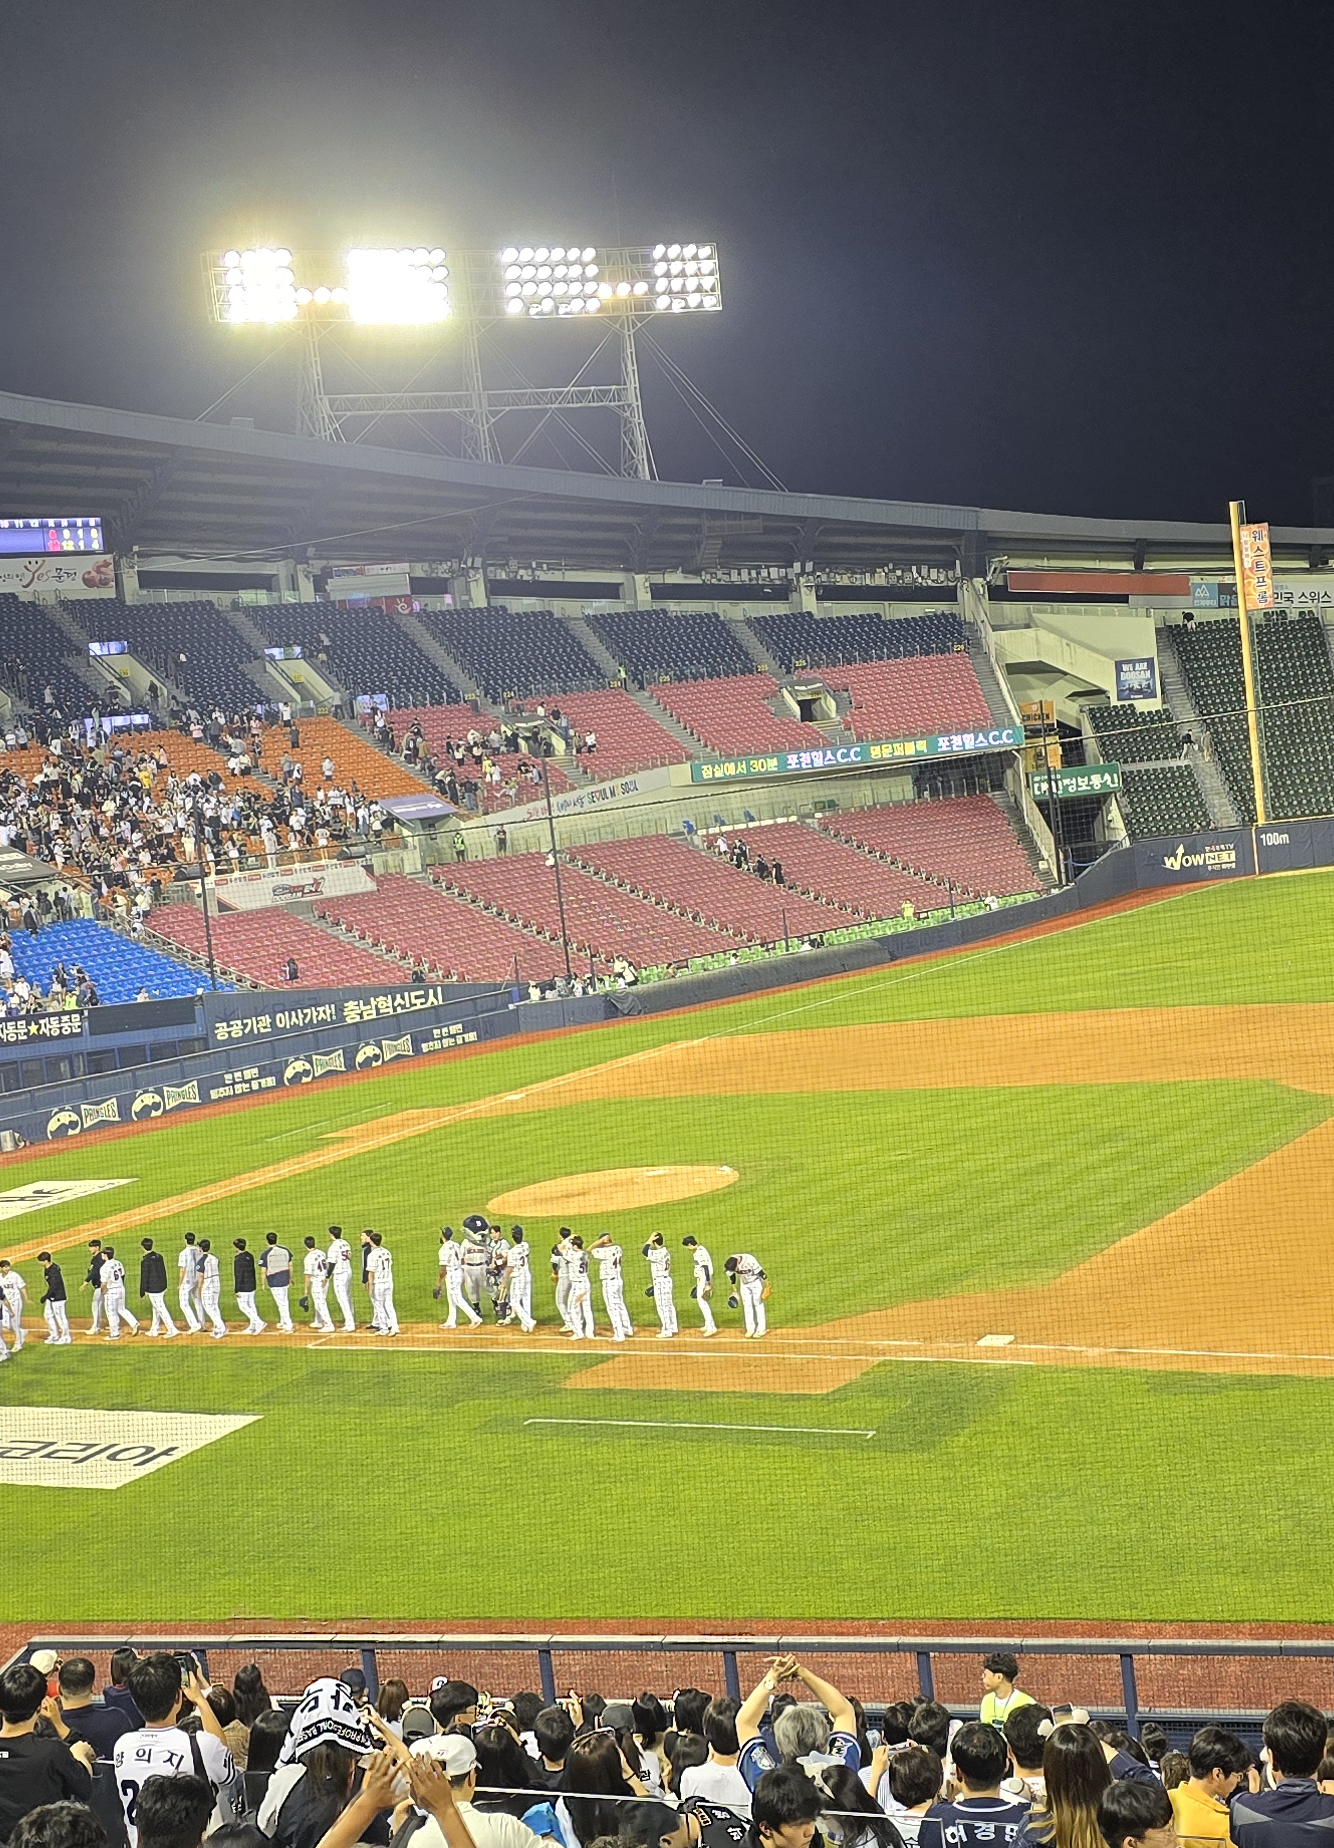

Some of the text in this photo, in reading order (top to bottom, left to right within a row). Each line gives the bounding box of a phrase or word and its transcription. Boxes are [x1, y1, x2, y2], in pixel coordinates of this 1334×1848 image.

[1273, 592, 1294, 605] 민국
[1298, 591, 1334, 605] 스위스
[701, 760, 747, 779] 잠실에서
[750, 757, 779, 772] 30분
[1260, 833, 1289, 846] 100m
[214, 986, 444, 1041] 공공기관 이사가자! 충남혁신도시
[39, 1014, 82, 1036] 자동중문
[384, 1038, 411, 1058] PRINGLES
[316, 1054, 344, 1073] PRINGLES
[166, 1084, 198, 1104] PRINGLES
[83, 1103, 117, 1122] PRINGLES
